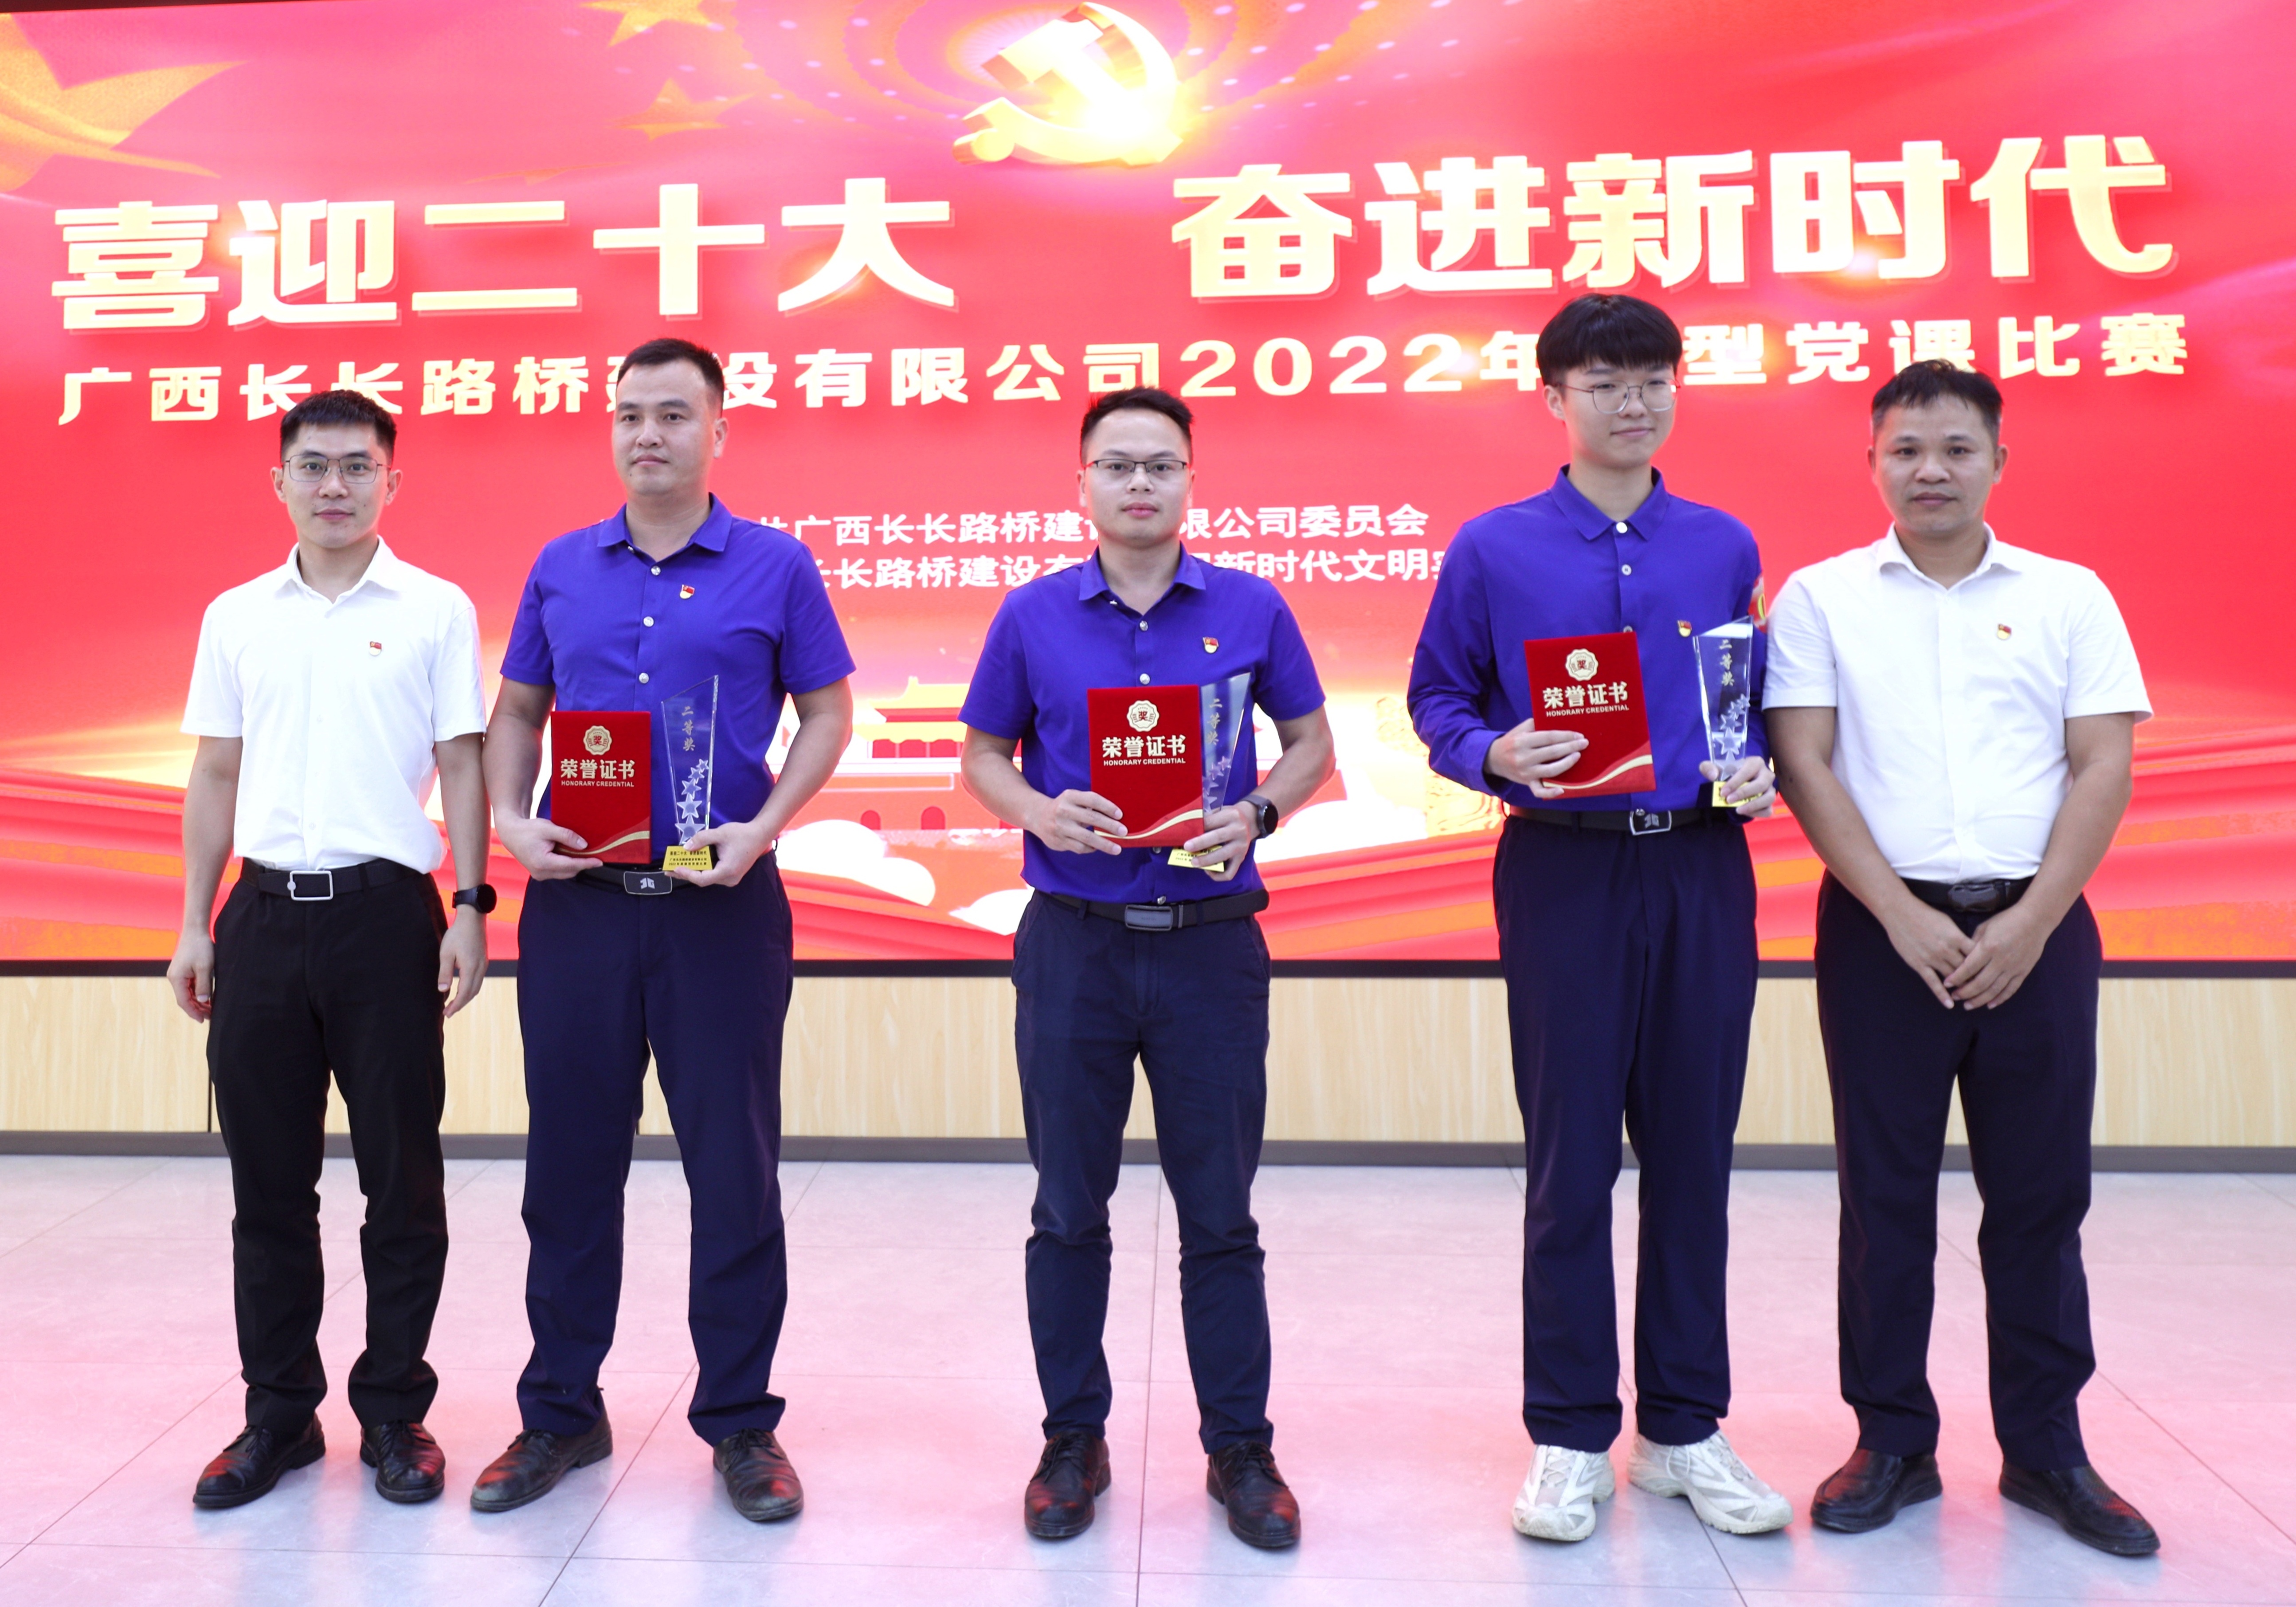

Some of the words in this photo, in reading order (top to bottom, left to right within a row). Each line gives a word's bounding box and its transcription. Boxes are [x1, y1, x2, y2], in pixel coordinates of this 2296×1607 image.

[51, 178, 955, 329] 喜迎二十大
[1171, 134, 2174, 299] 奋进新时代
[1719, 639, 1735, 686] 二等奖
[1543, 681, 1628, 709] 荣誉证书
[1138, 711, 1148, 721] 奖
[1207, 698, 1222, 745] 二等奖
[1546, 708, 1585, 717] HONORARY
[1586, 704, 1630, 714] CREDENTIAL
[593, 735, 603, 745] 奖
[682, 706, 696, 752] 二等奖
[1102, 734, 1186, 759] 荣誉证书
[560, 759, 635, 780] 荣誉证书
